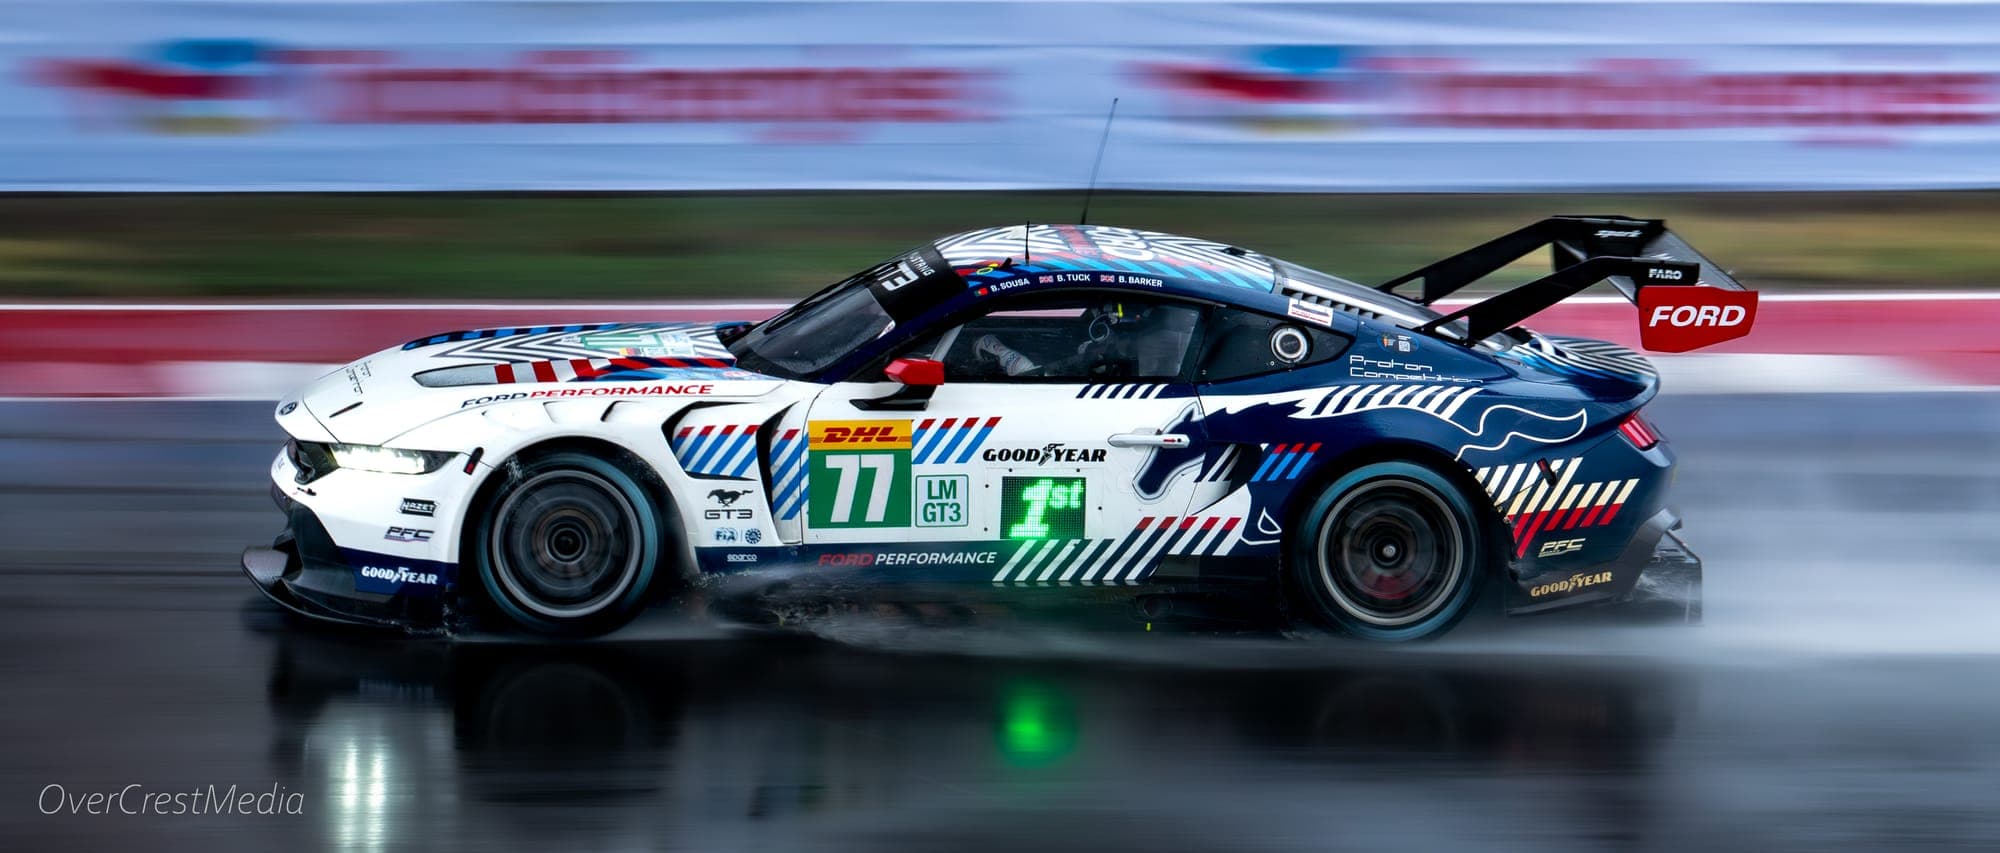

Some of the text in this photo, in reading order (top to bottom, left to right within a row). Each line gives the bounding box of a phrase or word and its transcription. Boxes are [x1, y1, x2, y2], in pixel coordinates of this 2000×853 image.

[1056, 272, 1091, 283] B. TUCK
[1118, 275, 1163, 289] B. BARKER
[1648, 267, 1683, 281] FARO
[989, 277, 1031, 294] B. SOUSA
[1648, 304, 1746, 328] FORD
[1349, 354, 1433, 373] Proton
[460, 384, 714, 409] FORD PERFORMANCE
[821, 426, 901, 443] DHL
[982, 442, 1108, 466] GOODYEAR
[825, 453, 895, 523] 77
[926, 479, 957, 500] LM
[704, 508, 753, 520] GT3
[922, 503, 962, 523] GT3
[1008, 479, 1084, 539] 1st
[385, 525, 436, 540] PFC
[1540, 537, 1586, 553] PFC
[817, 551, 998, 567] FORD PERFORMANCE
